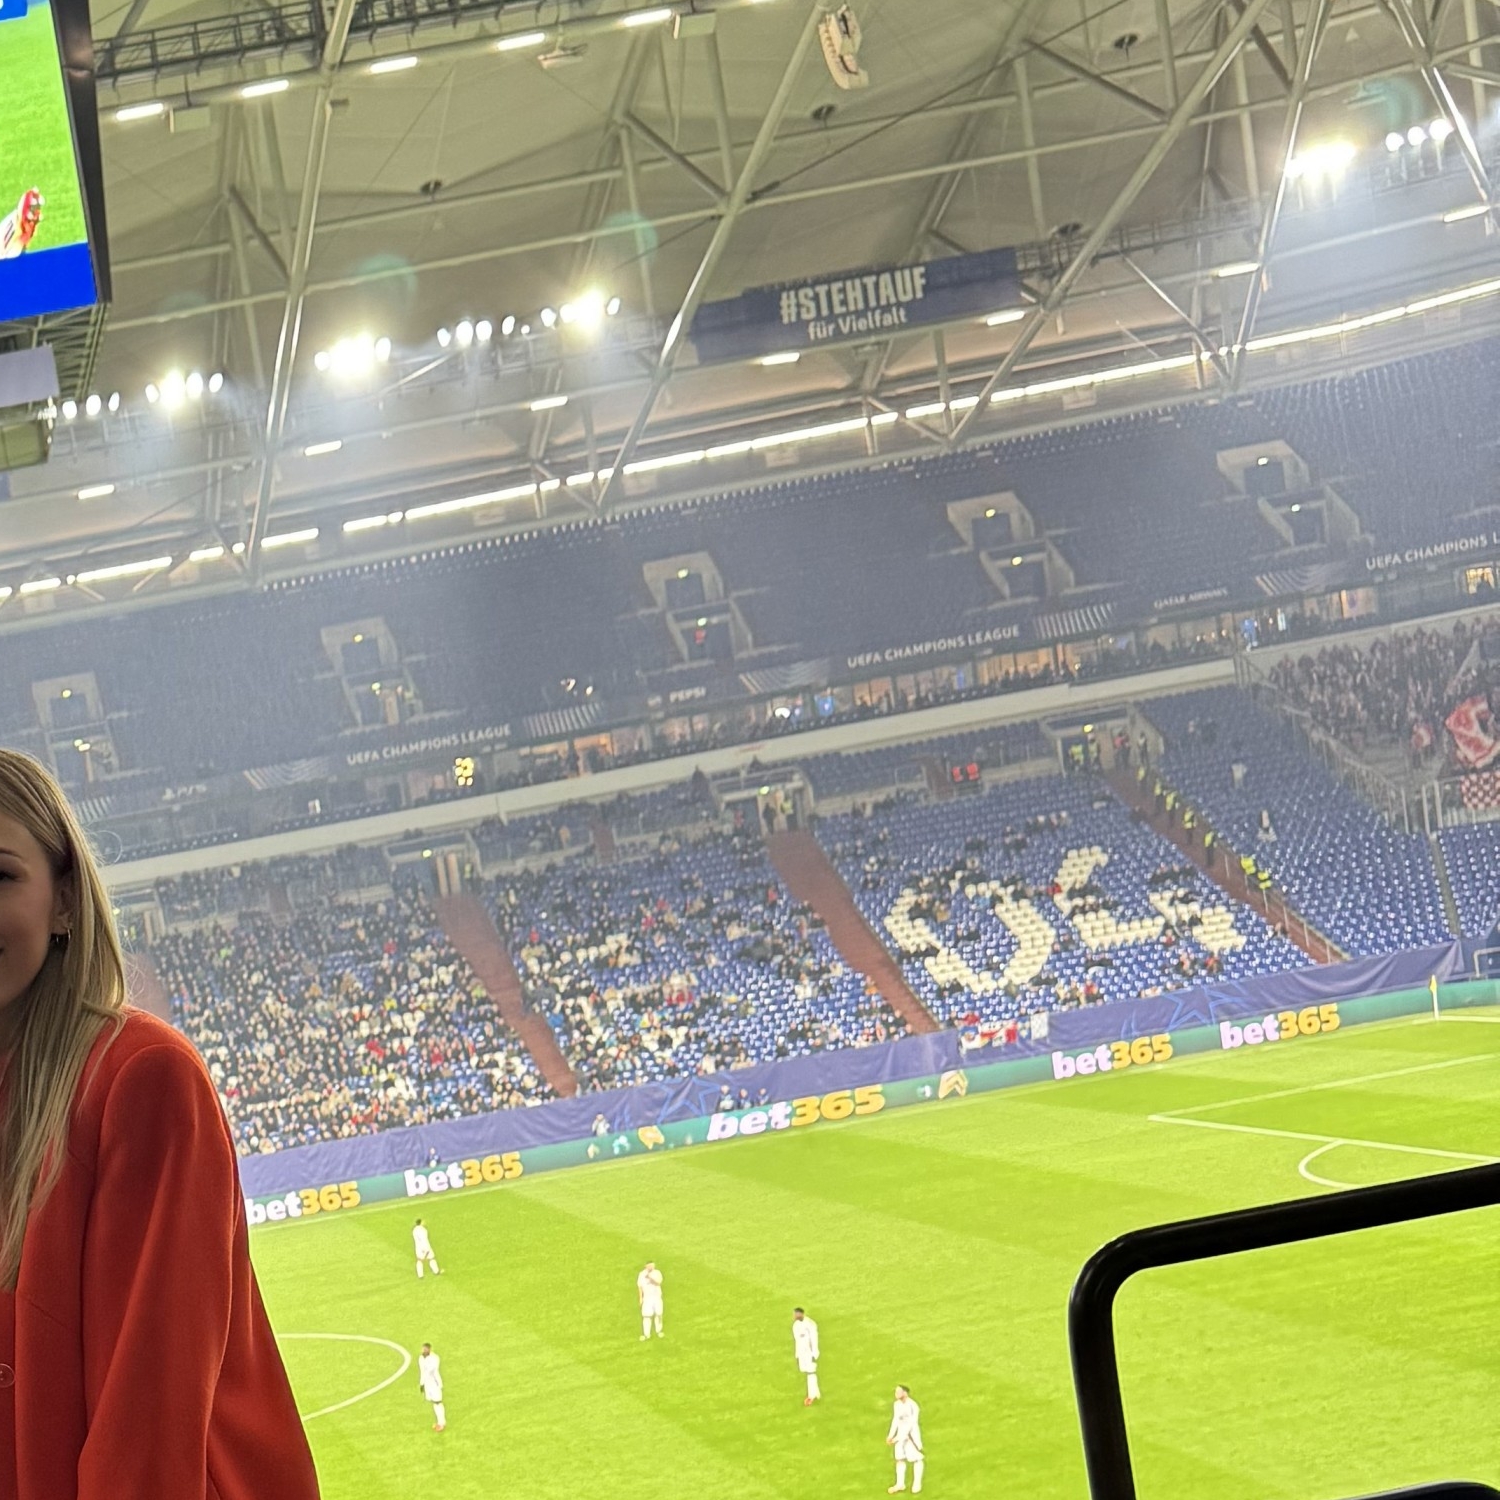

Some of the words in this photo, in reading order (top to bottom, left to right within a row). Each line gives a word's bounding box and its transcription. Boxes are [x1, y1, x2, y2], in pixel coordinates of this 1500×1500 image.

[780, 267, 926, 324] #STEHTAUF
[808, 321, 835, 340] für
[839, 308, 908, 334] Vielfalt
[1366, 553, 1401, 570] UEFA
[1405, 534, 1487, 562] CHAMPIONS
[847, 652, 881, 668] UEFA
[884, 635, 965, 661] CHAMPIONS
[968, 625, 1020, 645] LEAGUE
[347, 751, 379, 765] UEFA
[382, 735, 459, 758] CHAMPIONS
[461, 723, 511, 743] LEAGUE
[1219, 1003, 1340, 1050] bet365
[1052, 1033, 1173, 1080] bet365
[706, 1084, 886, 1142] bet365
[404, 1151, 523, 1197] bet365
[249, 1181, 361, 1224] bet365
